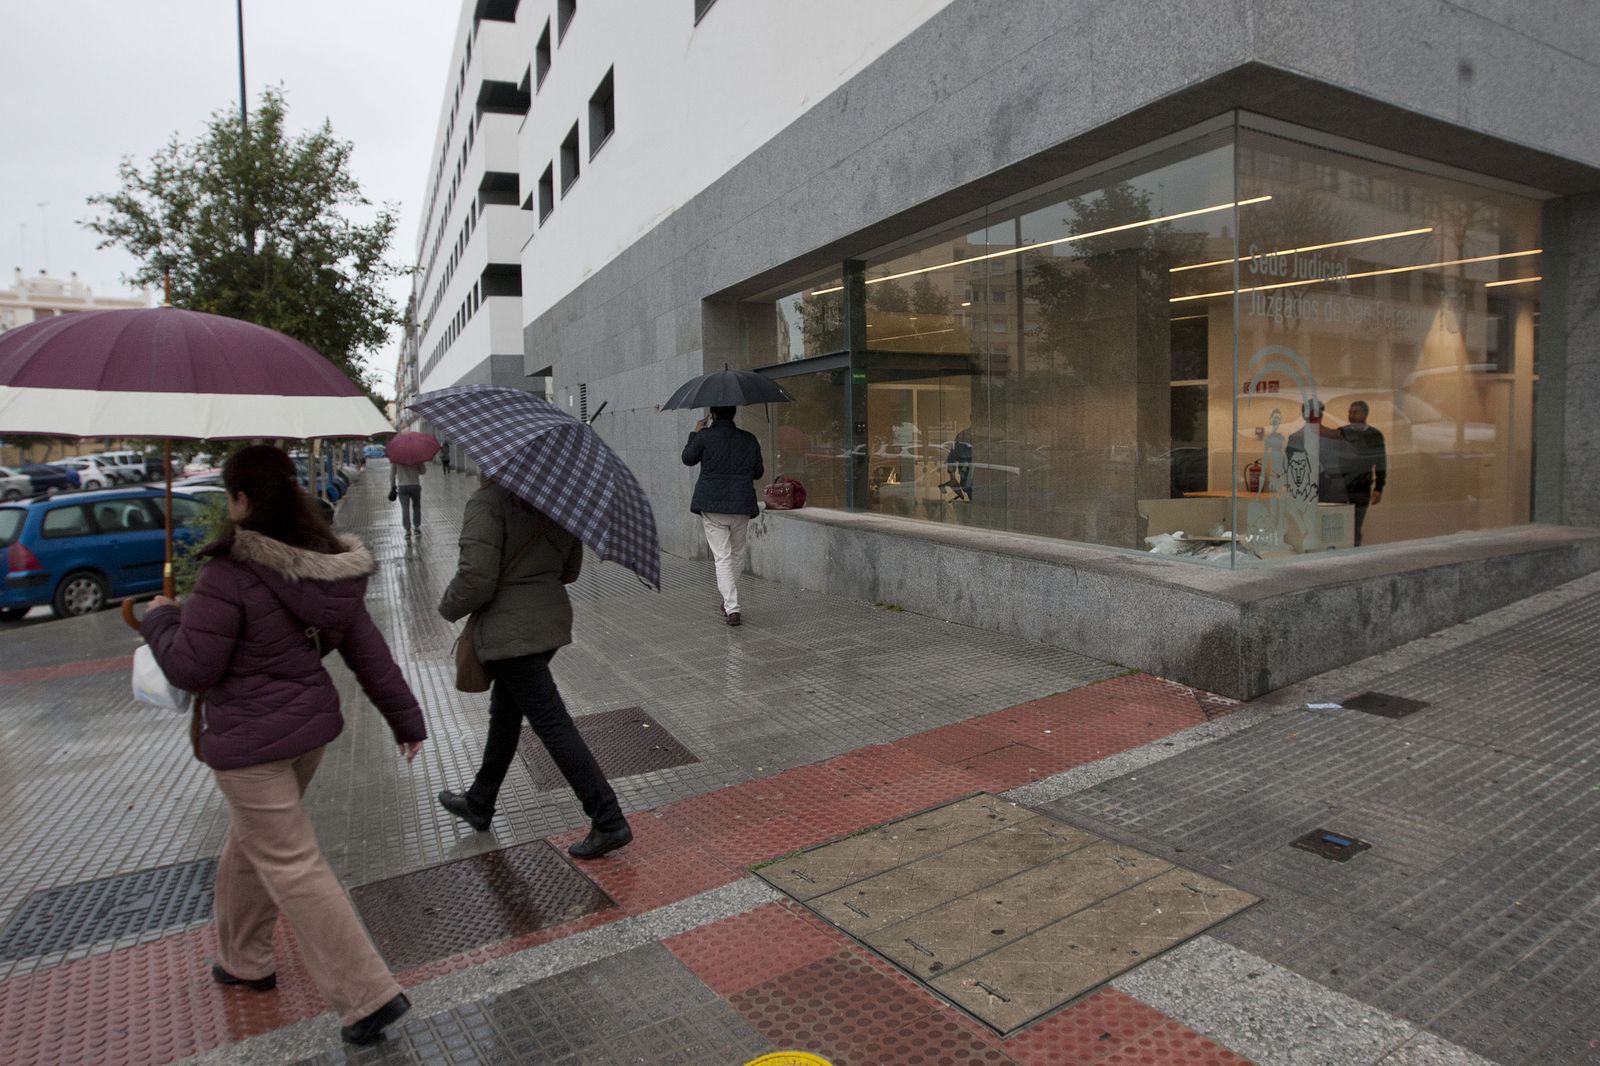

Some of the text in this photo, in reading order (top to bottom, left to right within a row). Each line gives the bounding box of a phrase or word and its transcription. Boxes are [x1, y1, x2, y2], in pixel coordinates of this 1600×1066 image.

[1249, 243, 1348, 283] Sede Judicial
[1248, 288, 1319, 323] Juzgados
[1323, 295, 1341, 322] de
